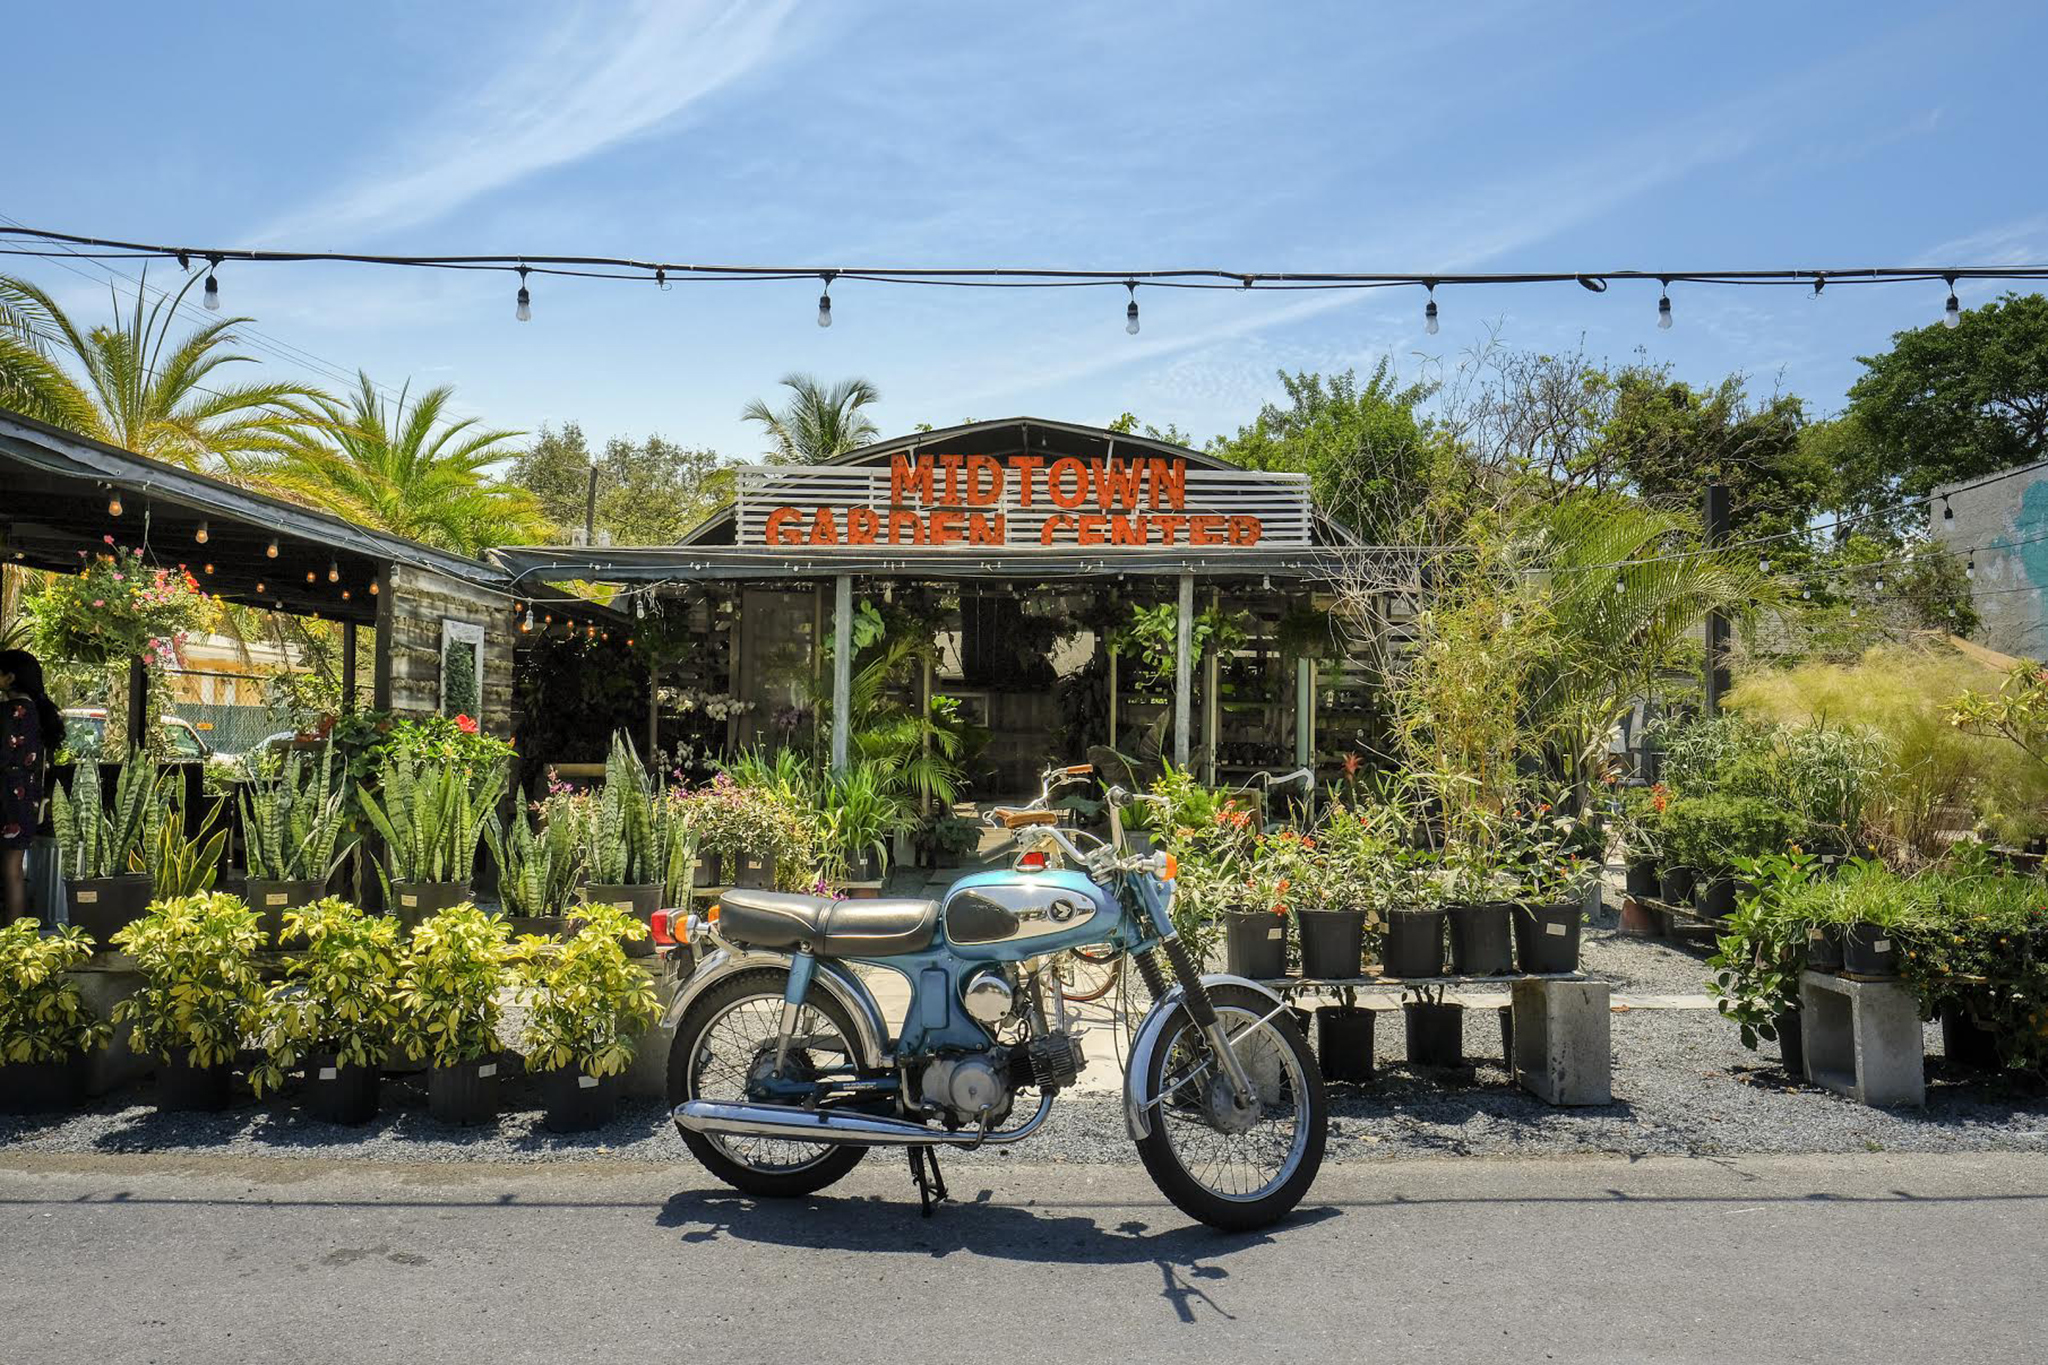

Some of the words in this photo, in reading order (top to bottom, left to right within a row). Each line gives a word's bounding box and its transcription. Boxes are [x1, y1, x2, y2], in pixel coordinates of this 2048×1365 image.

[890, 454, 1186, 510] MIDTOWN
[765, 506, 1005, 546] GARDEN
[1041, 514, 1262, 546] CENTER
